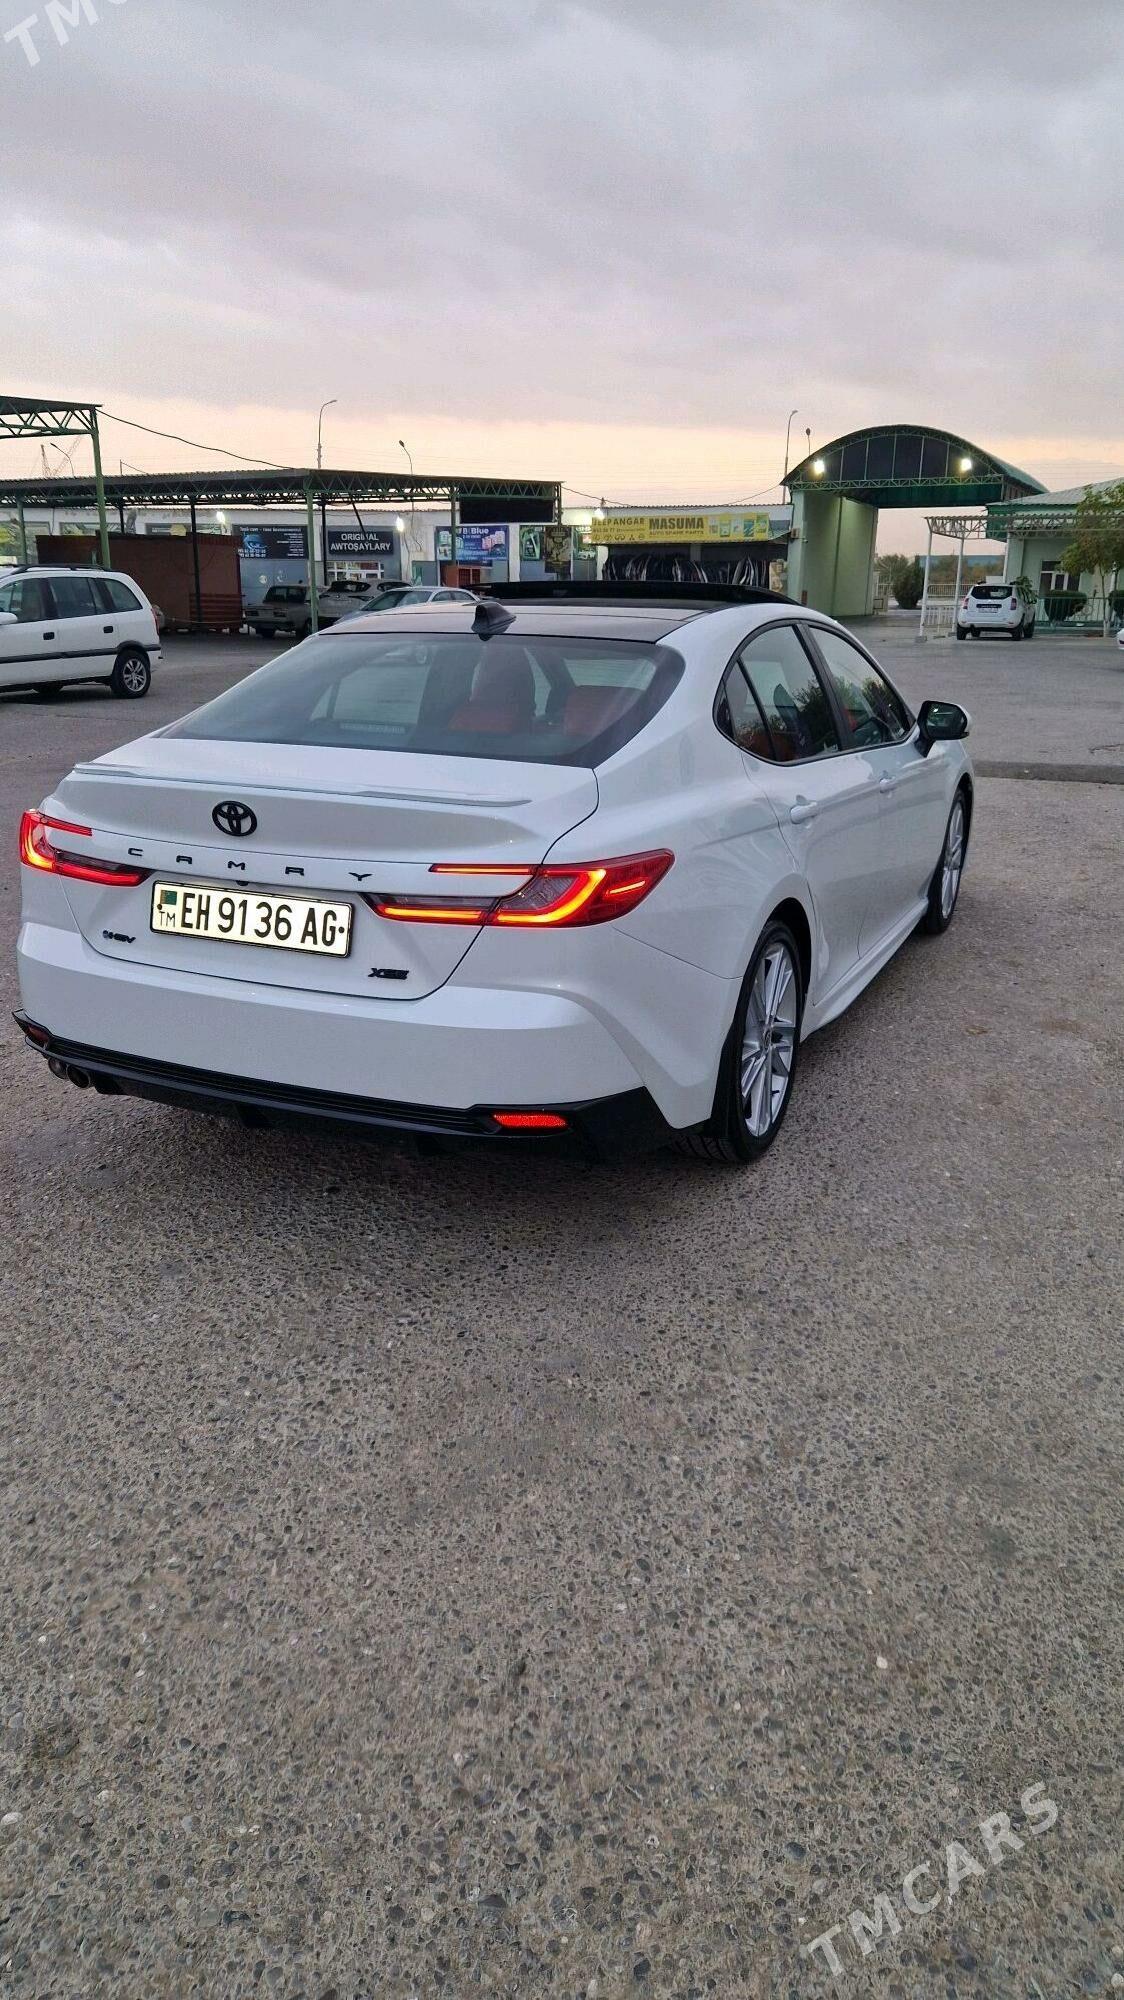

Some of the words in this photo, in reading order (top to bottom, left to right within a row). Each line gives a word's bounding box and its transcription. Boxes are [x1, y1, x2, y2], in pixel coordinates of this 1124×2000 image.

[649, 517, 704, 530] MASUMA
[127, 847, 372, 882] CAMRY
[159, 910, 176, 928] TM
[181, 892, 211, 931] EH
[217, 896, 292, 941] 9136
[300, 907, 338, 947] AG
